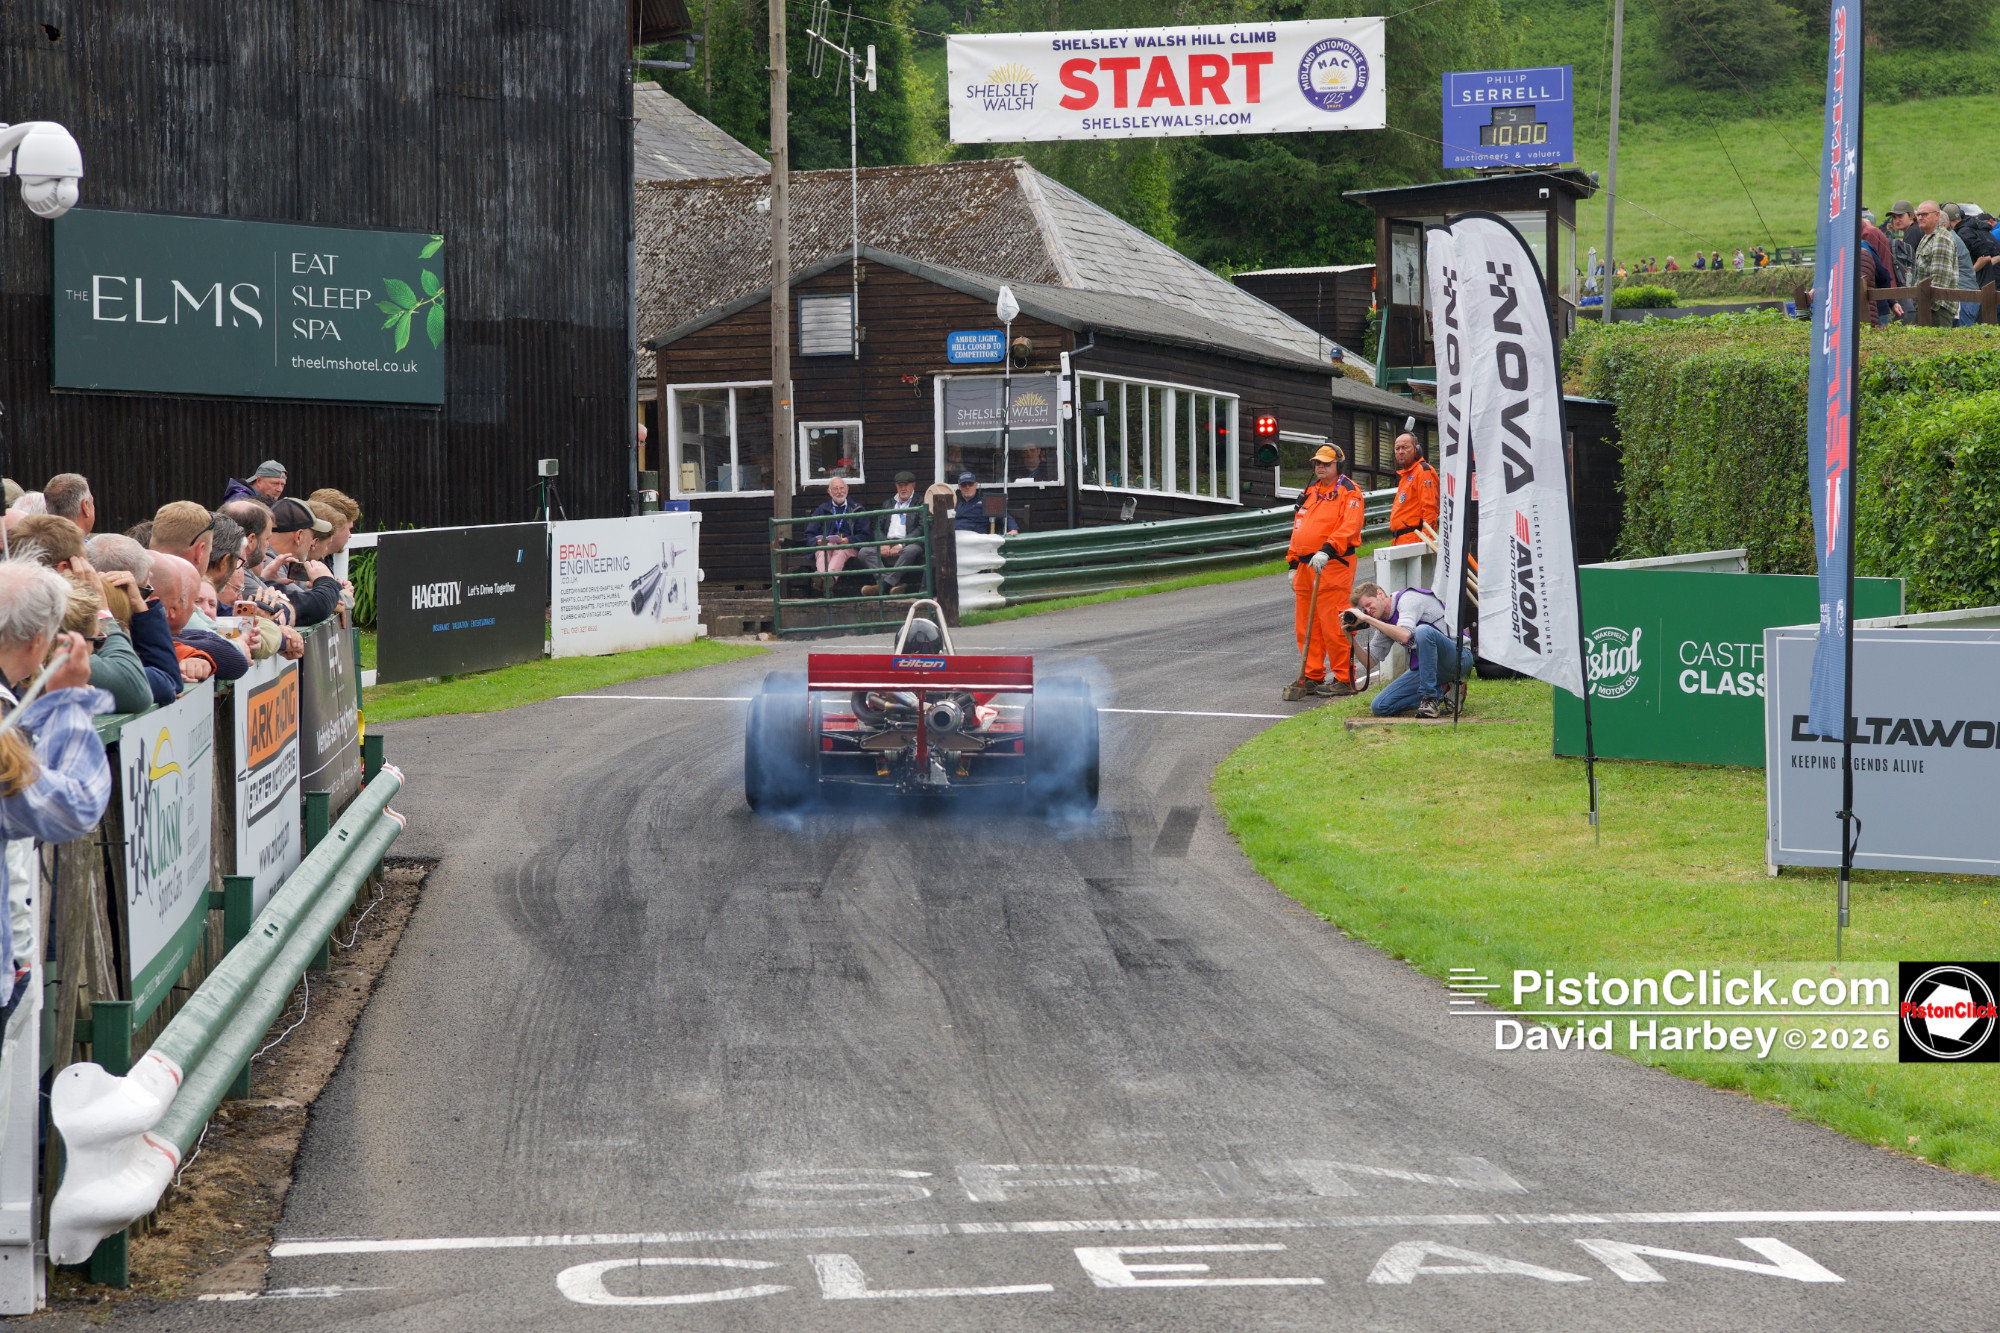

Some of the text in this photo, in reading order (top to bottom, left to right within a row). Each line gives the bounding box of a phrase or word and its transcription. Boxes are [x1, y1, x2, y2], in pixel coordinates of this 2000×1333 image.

[1052, 31, 1277, 52] SHELSLEY WALSH HILL CLIMB
[1301, 40, 1367, 91] MIDLAND AUTOMOBILE CLUB
[1317, 57, 1350, 70] MAC
[1058, 51, 1274, 111] START
[1486, 74, 1527, 85] PHILIP
[966, 82, 1039, 99] SHELSLEY
[1322, 92, 1345, 104] 125
[1462, 86, 1551, 102] SERRELL
[983, 97, 1035, 112] WALSH
[1082, 112, 1252, 130] SHELSLEYWALSH.COM
[1454, 150, 1561, 162] auctioneers & valuers
[291, 252, 339, 276] EAT
[65, 274, 263, 330] THE ELMS
[291, 285, 371, 310] SLEEP
[291, 317, 342, 342] SPA
[955, 334, 998, 343] AMBER LIGHT
[951, 342, 1002, 351] HILL CLOSED TO
[954, 350, 999, 359] COMPETITORS
[291, 355, 418, 373] theelmshotel.co.uk
[1488, 284, 1535, 495] NOVA
[1012, 406, 1048, 417] WALSH
[1532, 504, 1543, 559] LICENSED
[560, 543, 597, 560] BRAND
[560, 556, 630, 576] ENGINEERING
[467, 585, 480, 597] Let's
[480, 583, 494, 596] Drive
[494, 581, 517, 596] Together
[1509, 534, 1522, 645] MOTORSPORT
[1516, 540, 1542, 656] AVON
[1539, 565, 1553, 655] MANUFACTURER
[1593, 630, 1627, 643] WAKEFIELD
[898, 658, 945, 668] tilton
[1598, 674, 1637, 697] MOTOR OIL
[250, 699, 274, 758] ARK
[1791, 754, 1837, 770] KEEPING
[1893, 759, 1924, 774] ALIVE
[149, 777, 183, 881] Classic
[556, 1236, 1846, 1304] CLEAN
